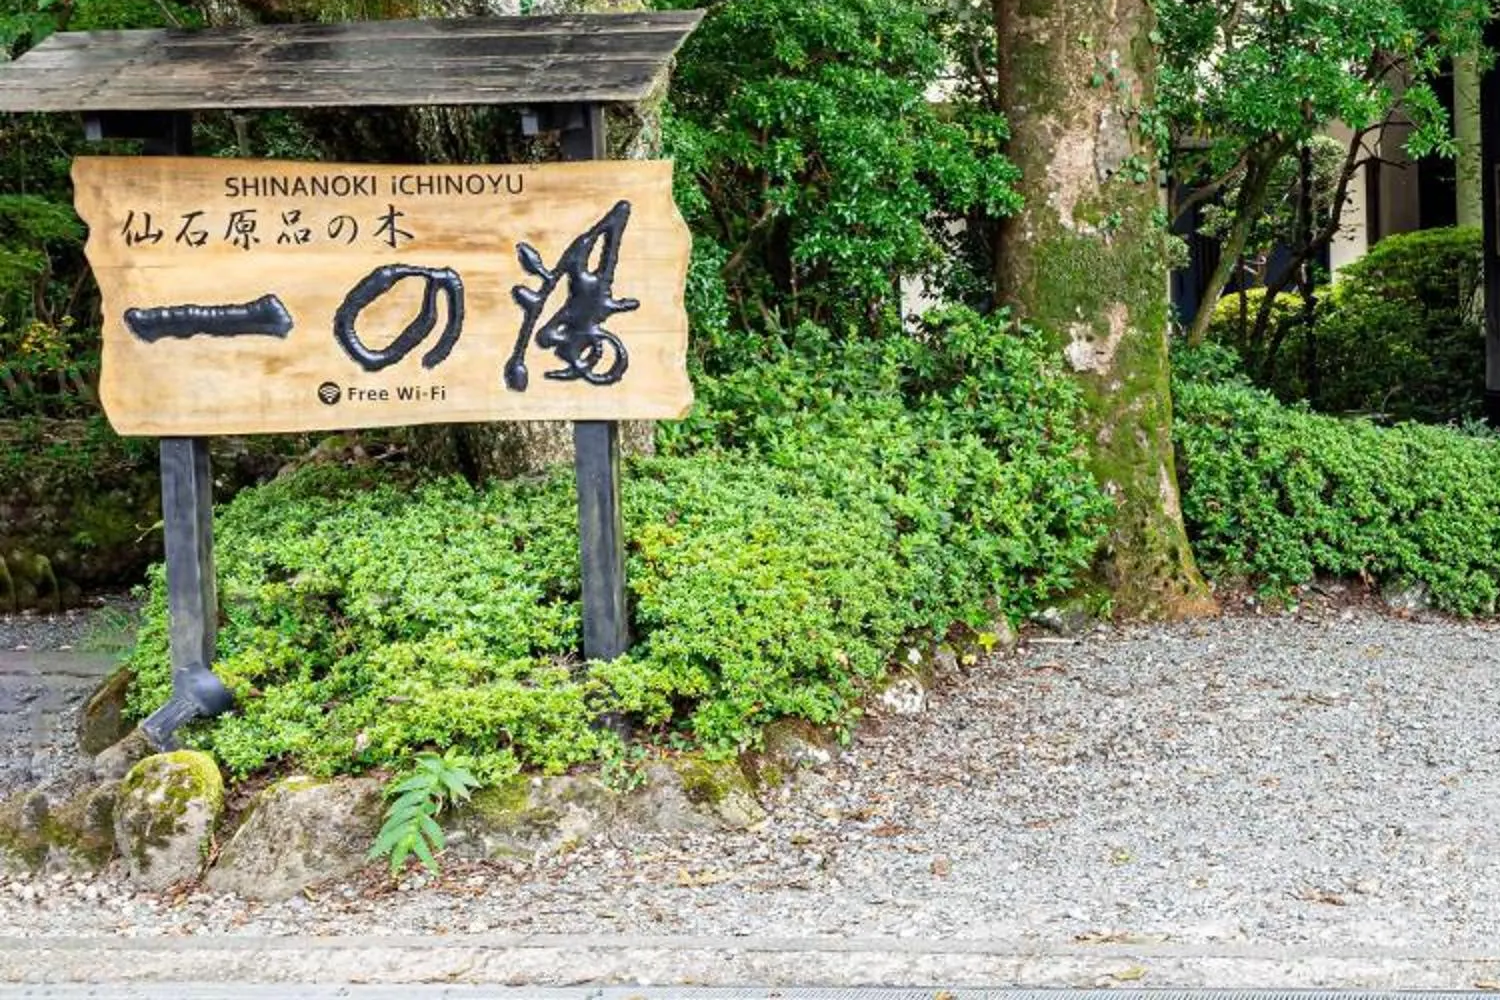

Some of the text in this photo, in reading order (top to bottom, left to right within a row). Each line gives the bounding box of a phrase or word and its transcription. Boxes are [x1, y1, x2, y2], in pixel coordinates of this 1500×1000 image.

[224, 175, 377, 198] SHINANOKI
[120, 203, 415, 251] 仙石原品の木
[122, 199, 642, 393] 一の湯
[347, 385, 447, 401] Free Wi-Fi
